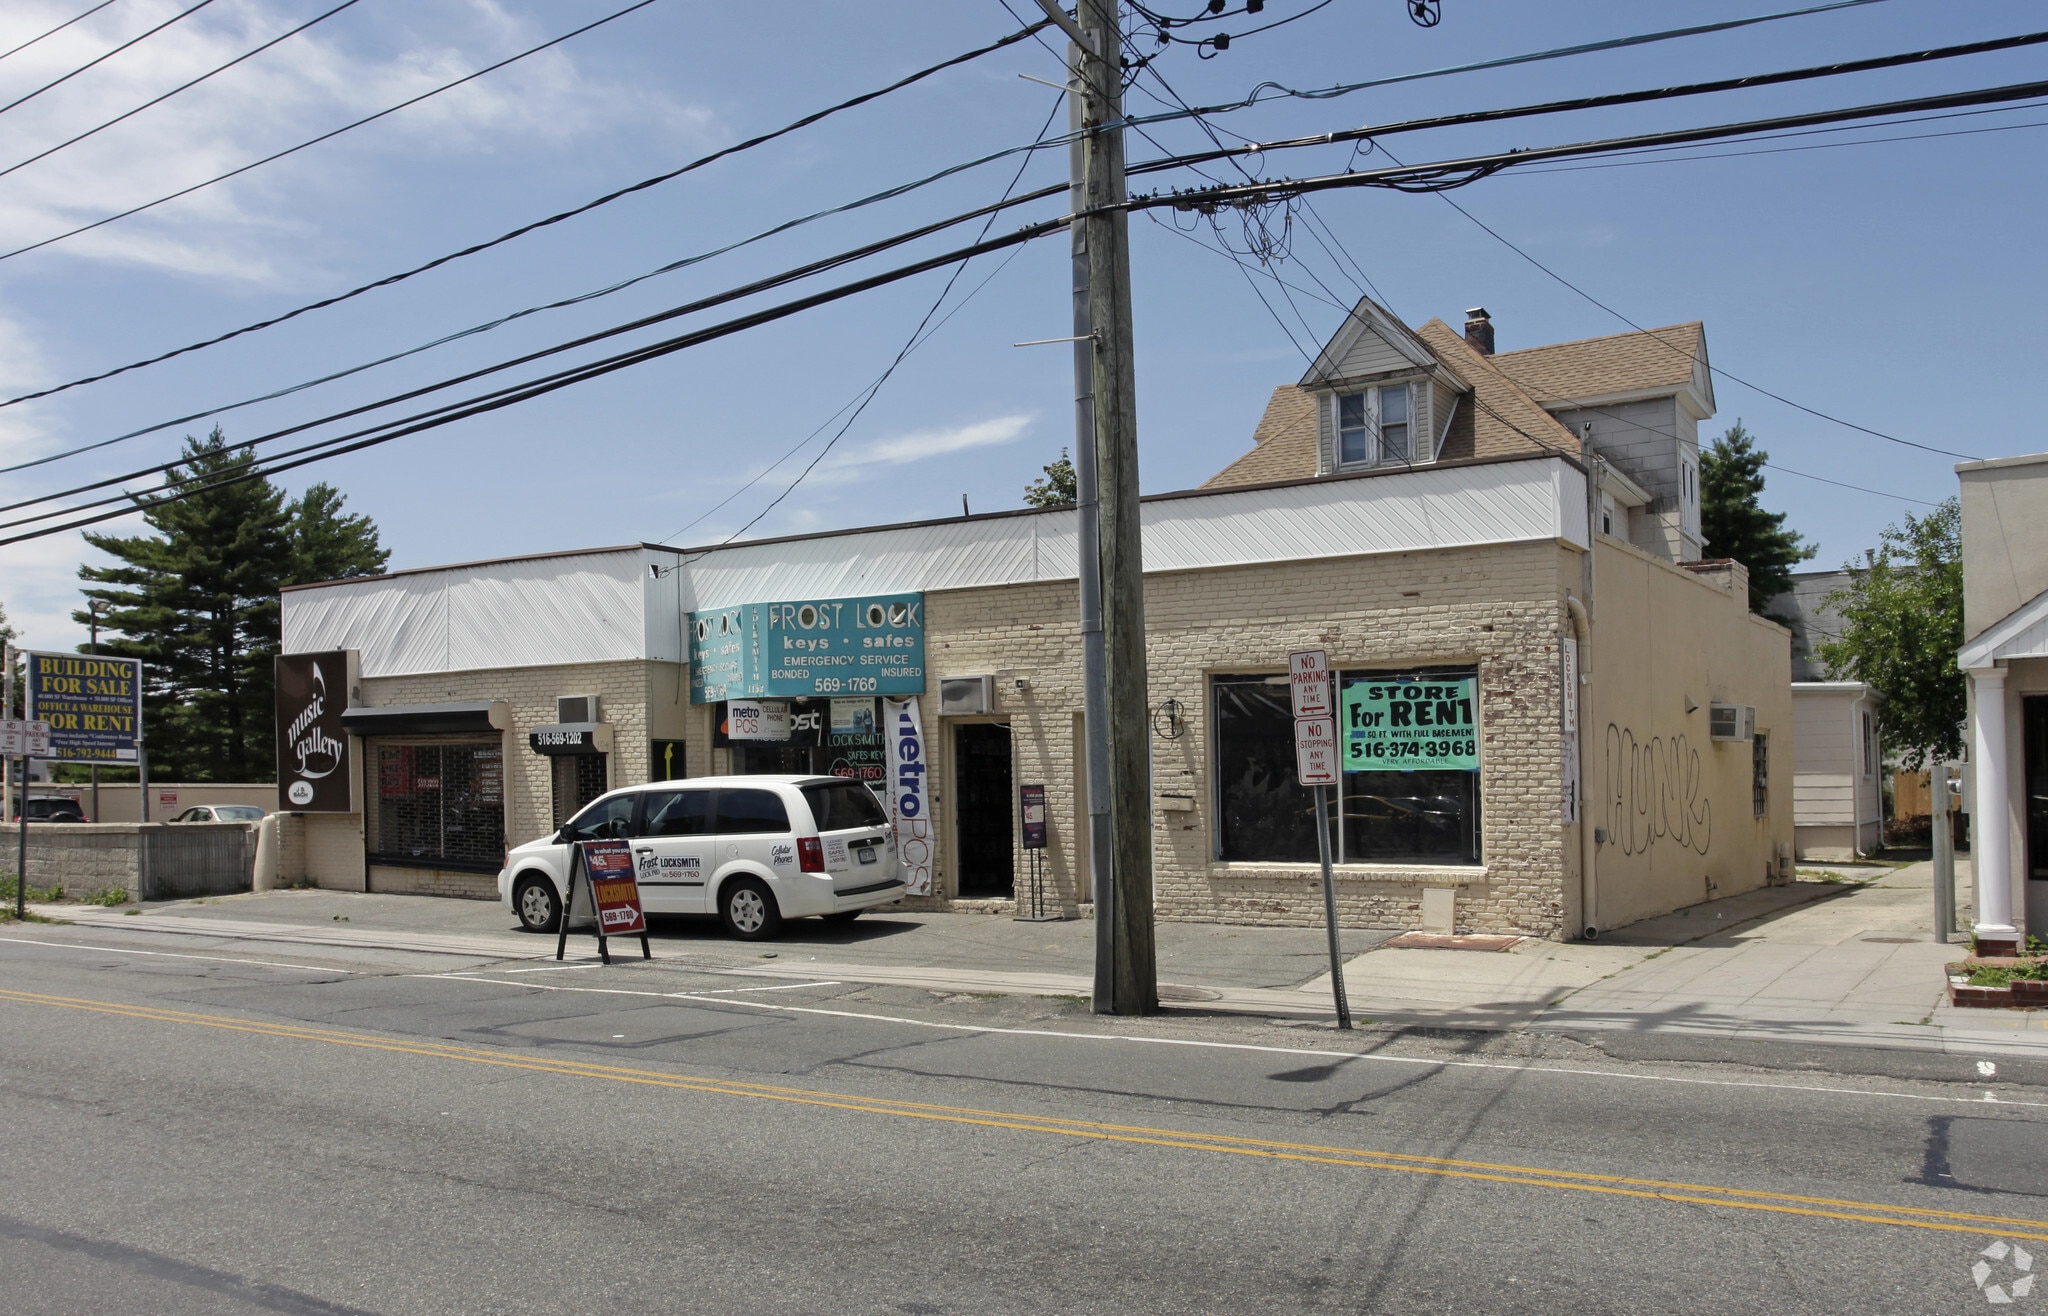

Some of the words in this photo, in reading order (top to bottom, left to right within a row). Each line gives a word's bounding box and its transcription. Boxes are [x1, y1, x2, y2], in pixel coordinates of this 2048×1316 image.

[769, 603, 844, 631] FROST
[856, 602, 920, 629] LOCK
[783, 635, 829, 652] keys
[863, 634, 915, 648] safes
[693, 648, 709, 661] keys
[720, 641, 740, 656] safes
[784, 655, 854, 666] EMERGENCY
[859, 654, 909, 665] SERVICE
[1301, 656, 1315, 669] NO
[39, 657, 133, 679] BUILDING
[771, 669, 810, 679] BONDED
[881, 667, 922, 678] INSURED
[1293, 670, 1326, 684] PARKING
[42, 676, 82, 694] FOR
[87, 678, 131, 696] SALE
[814, 677, 878, 692] 569-1760
[1303, 685, 1318, 694] ANY
[1564, 645, 1575, 728] LOCKSMITH
[1303, 694, 1321, 704] TIME
[1369, 686, 1459, 700] STORE
[38, 702, 70, 711] OFFICE
[71, 703, 78, 711] &
[80, 704, 133, 714] WAREHOUSE
[733, 706, 760, 719] metro
[1350, 702, 1384, 728] For
[1390, 698, 1473, 727] RENT
[38, 712, 78, 729] FOR
[84, 715, 133, 732] RENT
[287, 692, 324, 749] music
[766, 714, 784, 722] PHONE
[790, 709, 820, 731] ost
[735, 719, 758, 734] PCS
[1308, 724, 1322, 737] NO
[538, 732, 582, 745] 516-569-1202
[1367, 731, 1377, 739] SQ
[1391, 730, 1412, 738] WITH
[1414, 730, 1430, 738] FULL
[291, 726, 343, 774] gallery
[1300, 739, 1333, 748] STOPPING
[1350, 740, 1476, 758] 516-374-3968
[57, 747, 116, 758] 516-792-9444
[1309, 751, 1324, 760] ANY
[835, 767, 882, 779] 569-1760
[1309, 762, 1326, 771] TIME
[771, 844, 792, 856] Cellular
[639, 856, 659, 870] Frost
[660, 858, 700, 867] LOCKSMITH
[773, 855, 793, 866] Phones
[596, 882, 637, 903] LOCKSMITH
